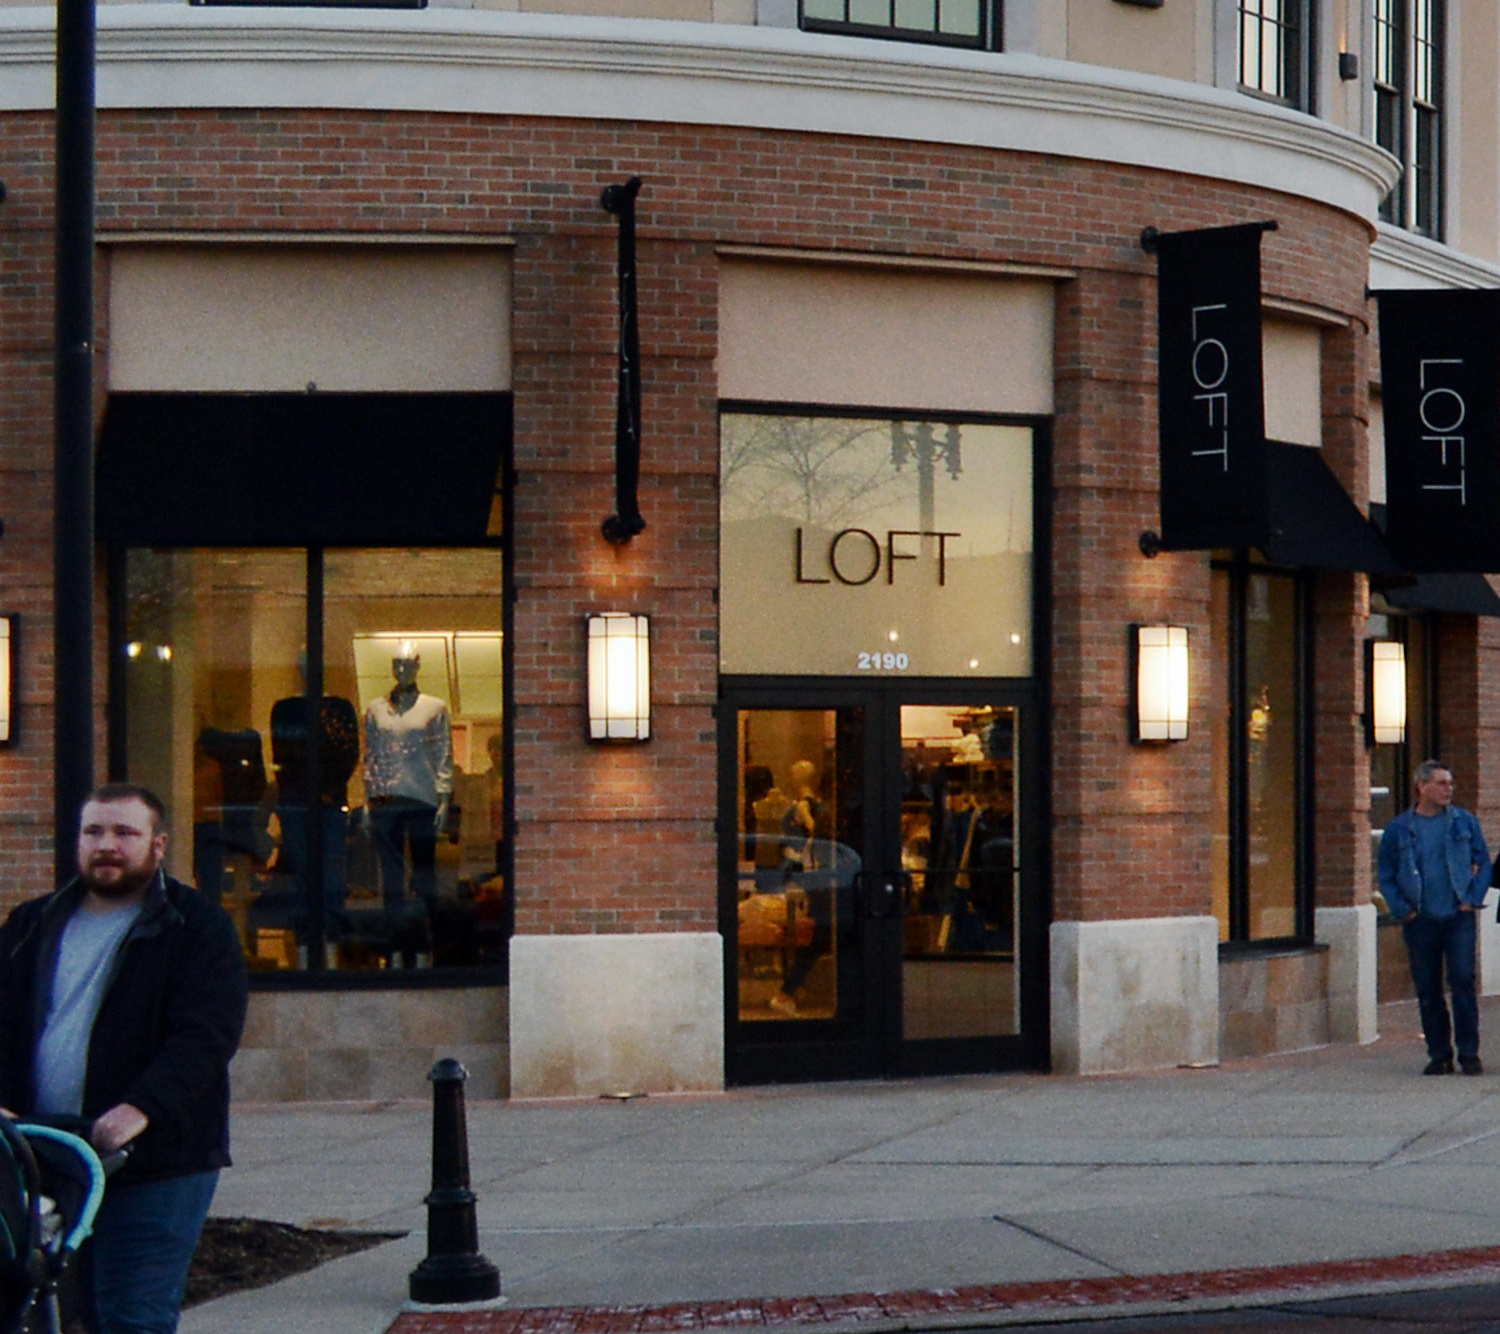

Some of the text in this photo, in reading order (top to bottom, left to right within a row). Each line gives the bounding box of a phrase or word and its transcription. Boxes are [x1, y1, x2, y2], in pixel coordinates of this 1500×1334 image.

[1192, 303, 1229, 472] LOFT
[1419, 358, 1466, 506] LOFT
[796, 526, 962, 587] LOFT
[857, 652, 909, 670] 2190
